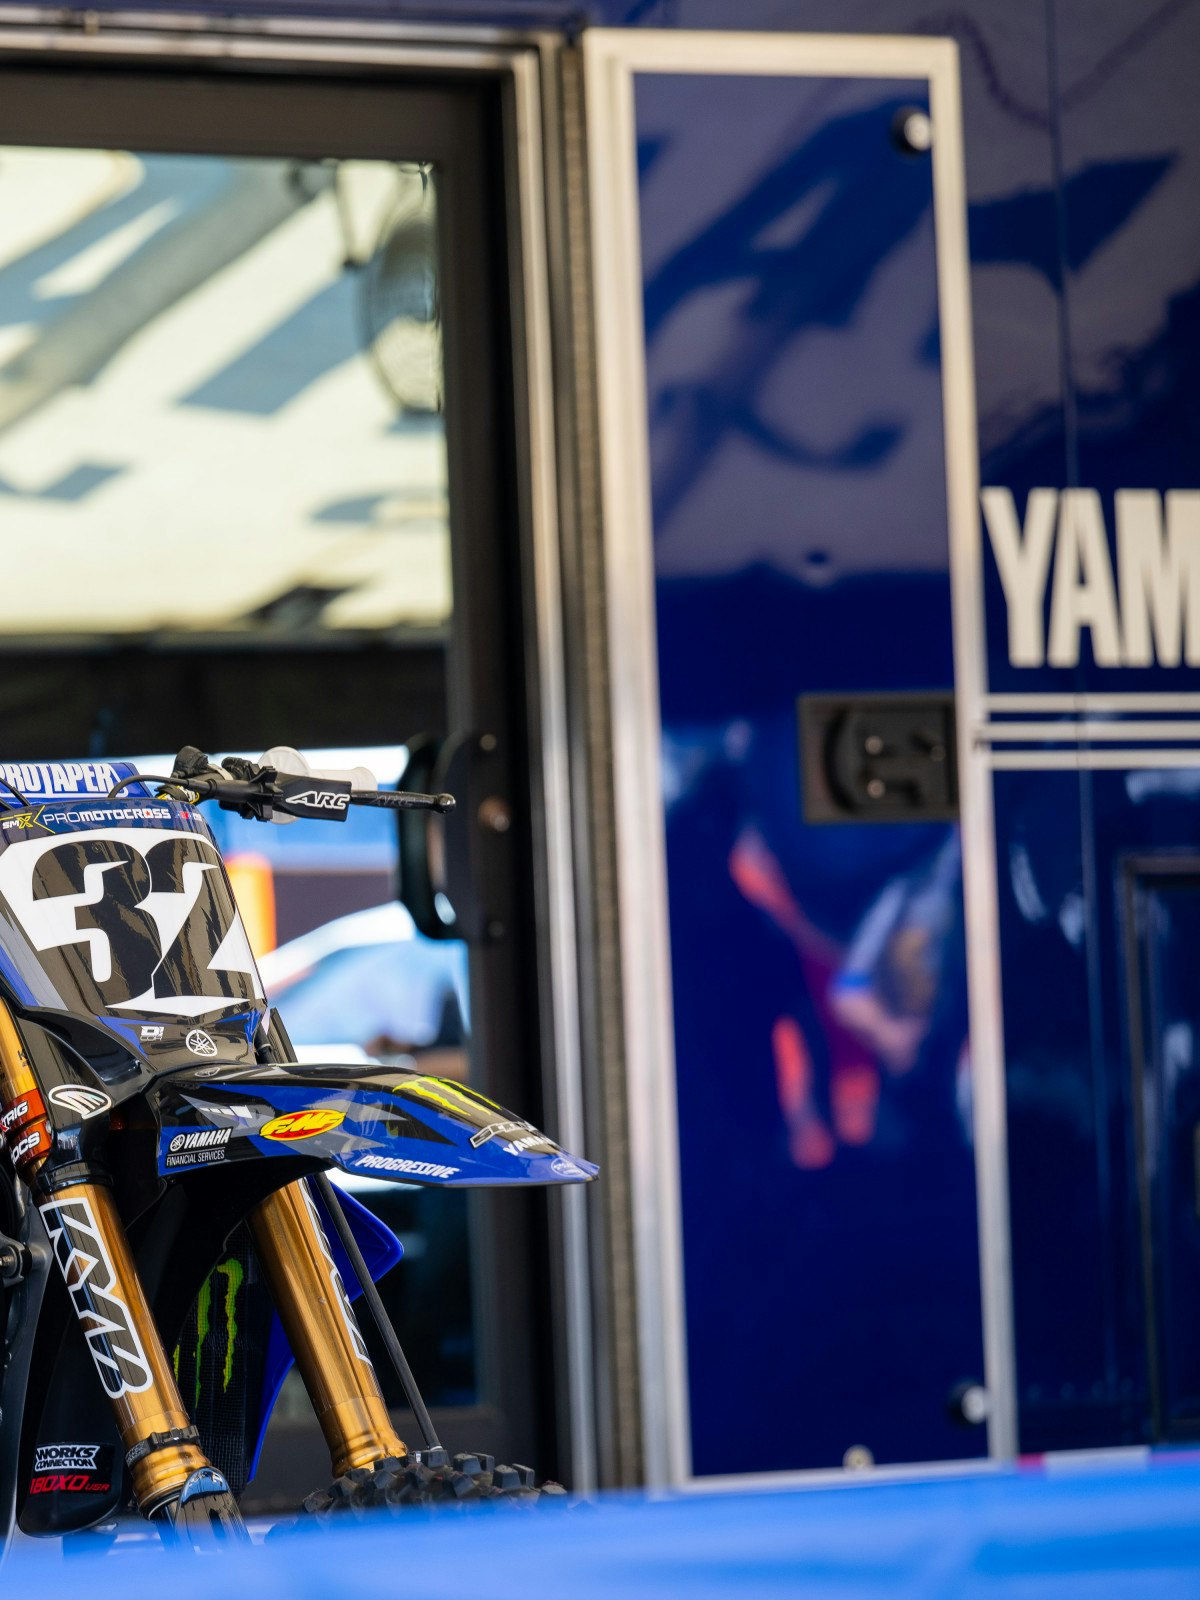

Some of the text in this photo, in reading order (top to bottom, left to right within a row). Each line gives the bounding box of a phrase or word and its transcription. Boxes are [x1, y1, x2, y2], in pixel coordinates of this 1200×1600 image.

[981, 486, 1200, 669] YAM
[286, 790, 350, 810] ARC
[31, 838, 266, 1001] 32
[260, 1112, 346, 1135] FMF
[184, 1127, 231, 1149] YAMAHA
[166, 1149, 225, 1167] FINANCIAL SERVICES
[355, 1155, 461, 1179] PROGRESSIVE
[38, 1197, 154, 1400] KYB
[37, 1446, 97, 1459] WORKS
[36, 1458, 94, 1470] CONNECTION
